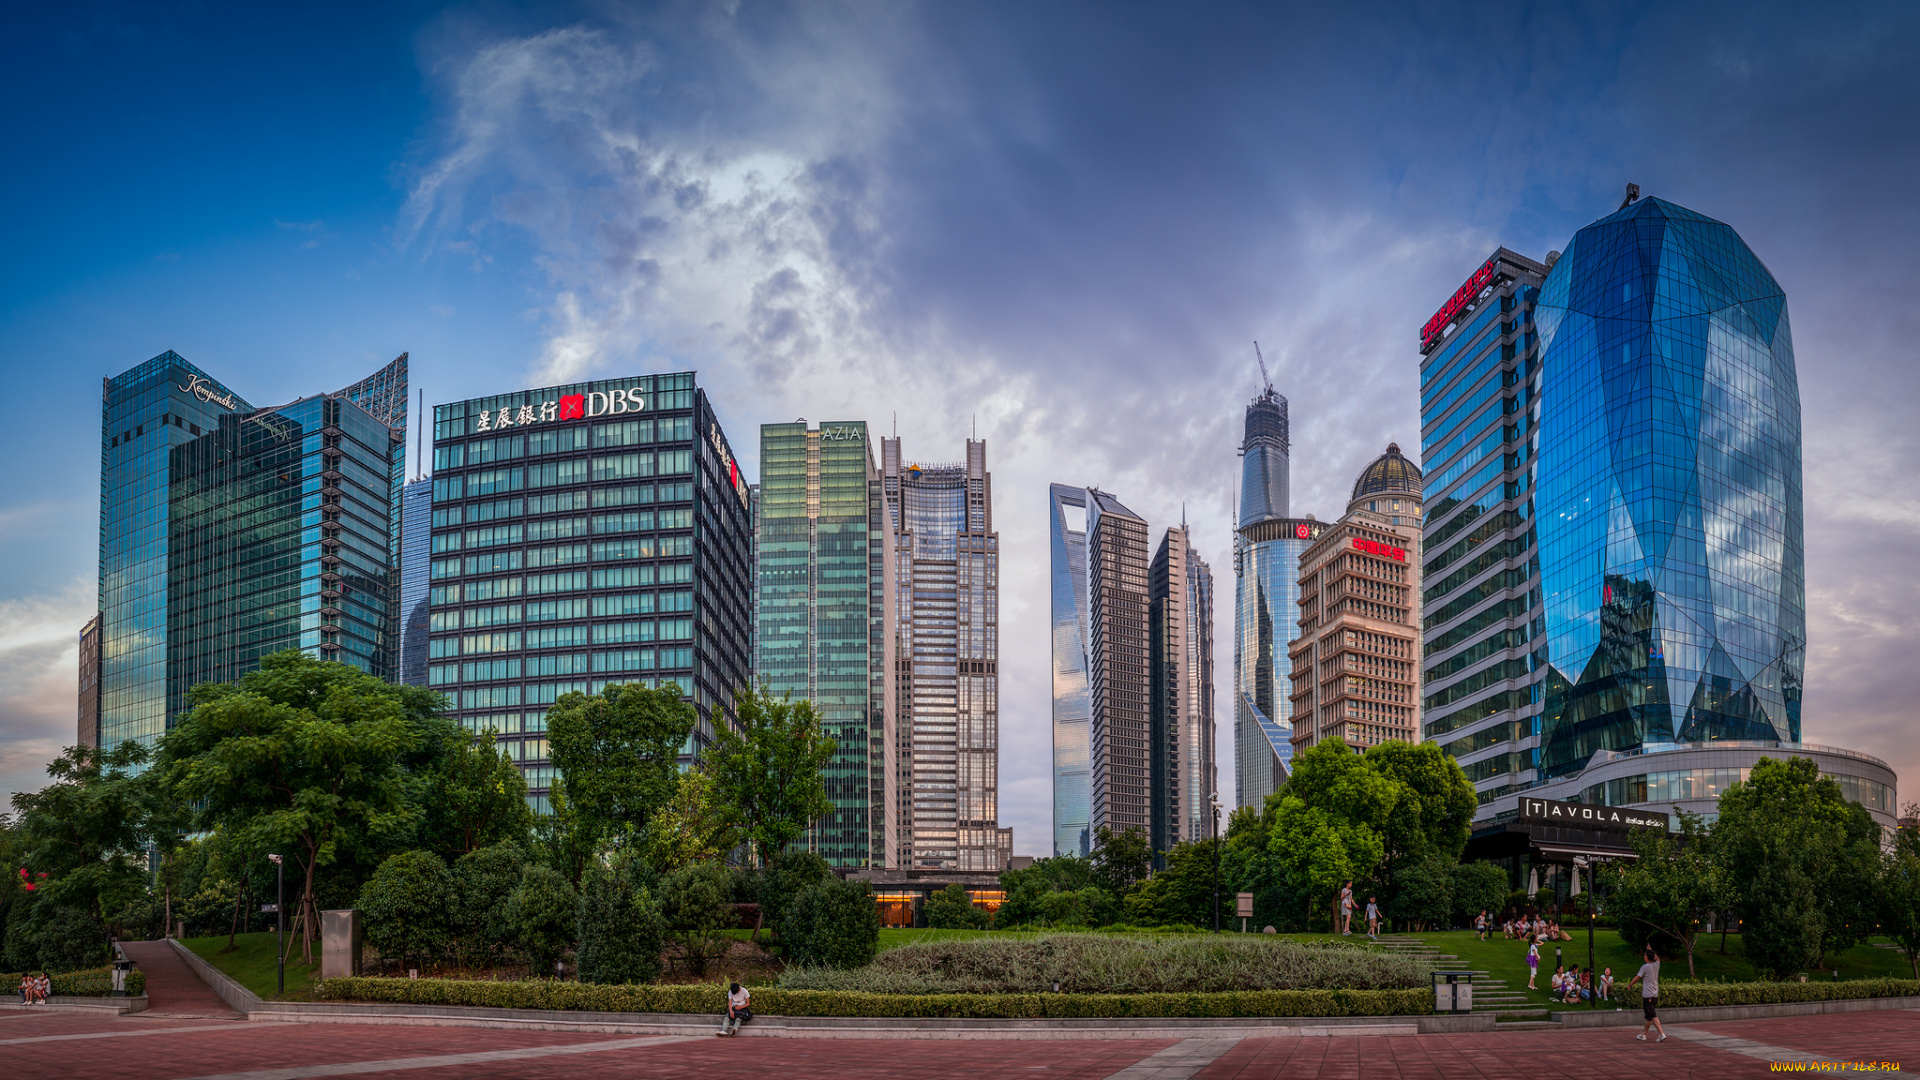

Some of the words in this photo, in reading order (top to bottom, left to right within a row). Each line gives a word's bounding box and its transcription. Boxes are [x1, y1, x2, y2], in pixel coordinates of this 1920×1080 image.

[178, 374, 237, 410] Kempinski
[587, 387, 645, 417] DBS
[477, 400, 559, 432] 星展銀行
[822, 426, 862, 441] AZIA
[1353, 537, 1405, 562] 中国平安
[1625, 816, 1645, 826] italian
